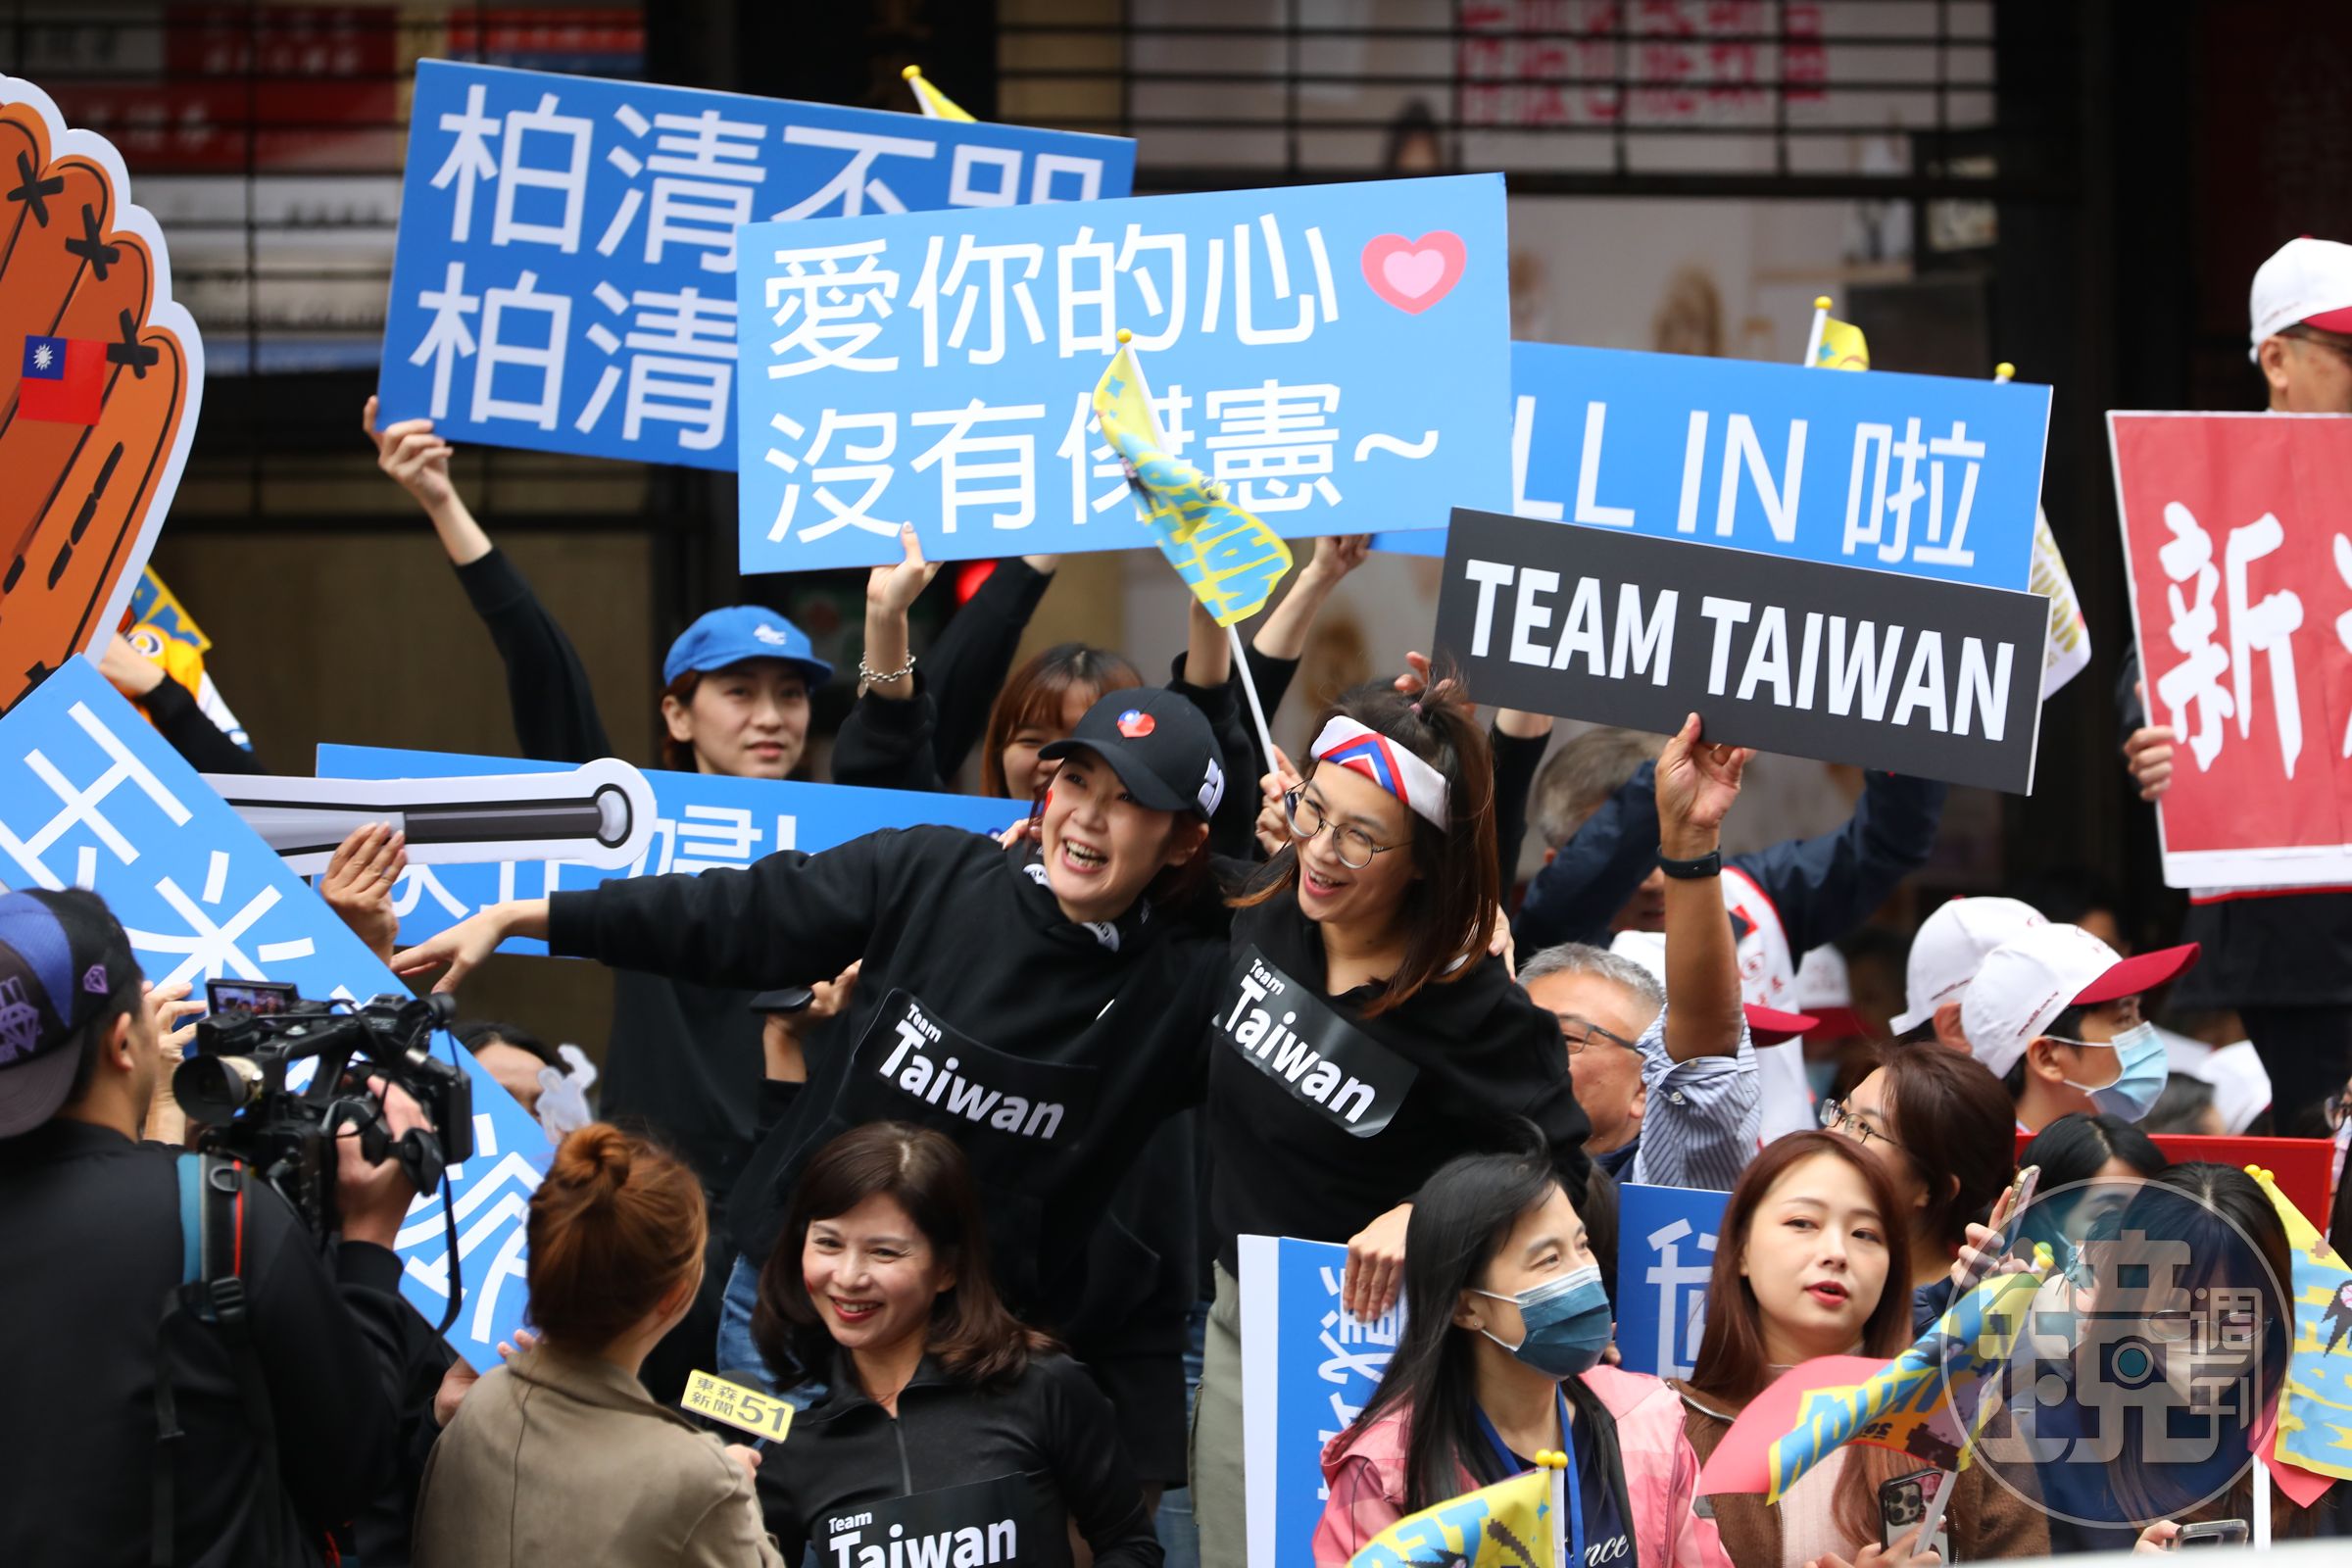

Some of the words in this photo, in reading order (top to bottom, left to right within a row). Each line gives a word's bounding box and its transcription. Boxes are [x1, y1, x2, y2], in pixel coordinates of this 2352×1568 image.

[764, 213, 1340, 379] 愛你的心
[1677, 410, 1808, 543] IN
[1841, 416, 1986, 568] 啦
[1464, 559, 1680, 687] TEAM
[1699, 595, 2015, 742] TAIWAN
[1249, 957, 1286, 996] Team
[0, 700, 530, 1345] 玉米派
[906, 1003, 943, 1043] Team
[1224, 974, 1376, 1124] Taiwan
[878, 1018, 1065, 1140] Taiwan
[689, 1391, 735, 1417] 新聞
[694, 1376, 738, 1402] 東森
[735, 1394, 787, 1434] 51
[828, 1511, 872, 1535] Team
[829, 1518, 1017, 1568] Taiwan
